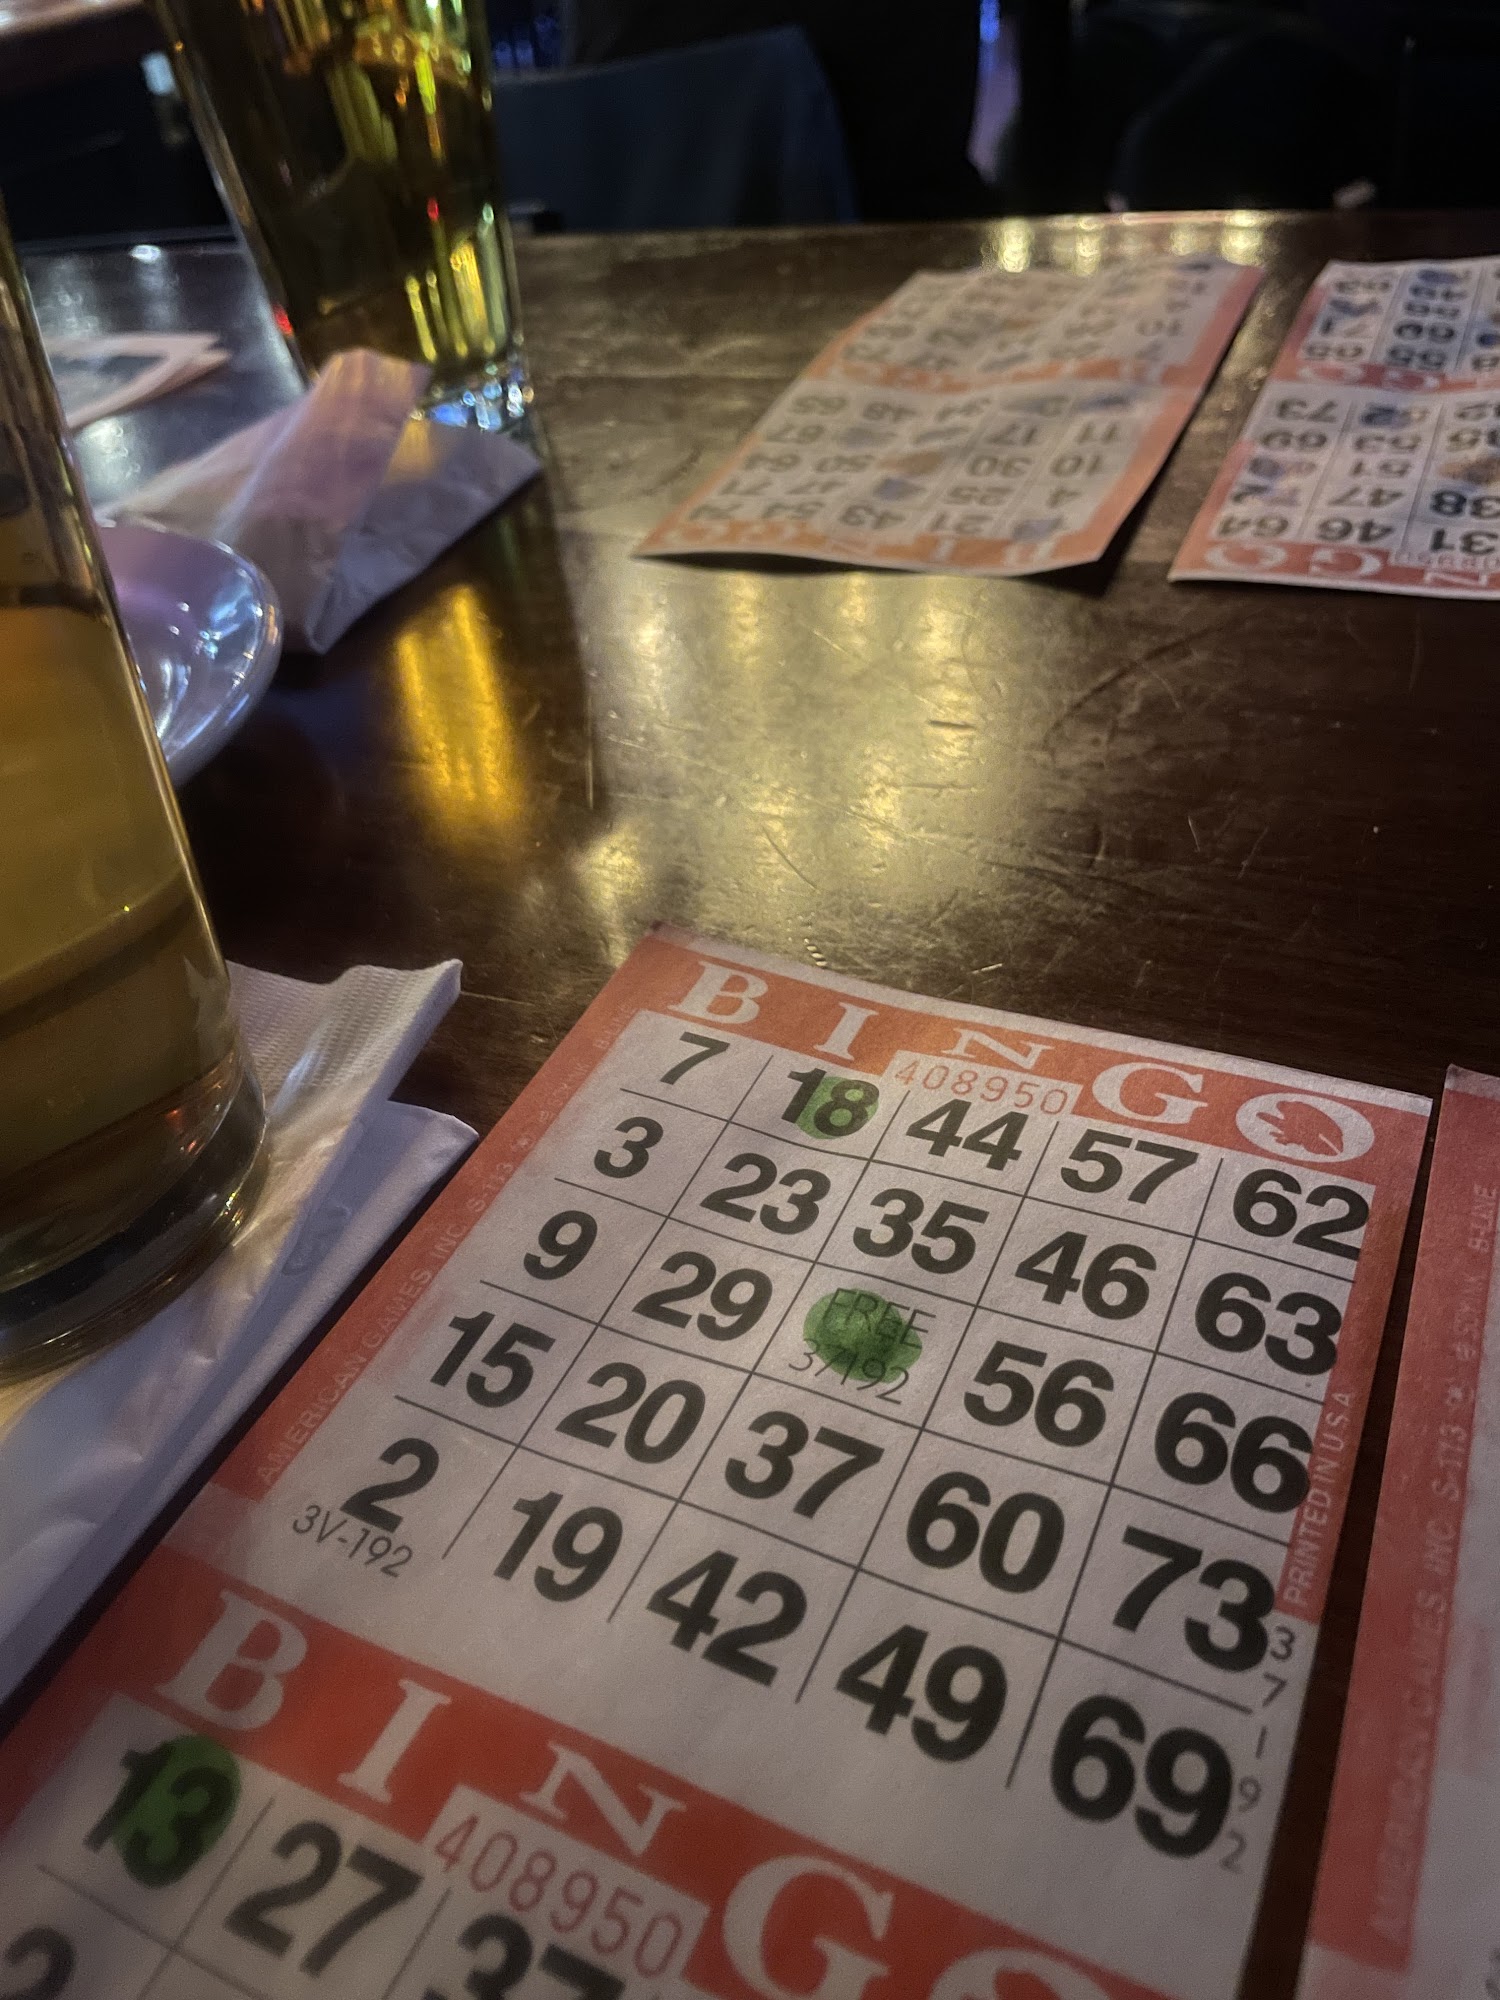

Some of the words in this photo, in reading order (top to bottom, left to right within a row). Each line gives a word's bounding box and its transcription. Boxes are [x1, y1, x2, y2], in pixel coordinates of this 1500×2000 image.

[1315, 515, 1396, 544] 46
[1428, 526, 1499, 556] 31
[659, 1031, 731, 1086] 7
[780, 1067, 880, 1137] 18
[906, 1098, 1030, 1172] 44
[1060, 1128, 1200, 1205] 57
[1232, 1168, 1370, 1262] 62
[895, 1059, 1071, 1116] 408950
[593, 1115, 665, 1179] 3
[700, 1152, 832, 1236] 23
[852, 1187, 991, 1275] 35
[1014, 1230, 1158, 1321] 46
[1194, 1272, 1343, 1376] 63
[821, 1287, 937, 1350] FREE
[522, 1209, 599, 1281] 9
[631, 1250, 774, 1342] 29
[962, 1340, 1115, 1448] 56
[1154, 1392, 1314, 1514] 66
[292, 1504, 414, 1579] 3V-192
[429, 1310, 557, 1408] 15
[555, 1361, 706, 1464] 20
[724, 1410, 885, 1519] 37
[905, 1471, 1066, 1594] 60
[1111, 1525, 1277, 1672] 73
[1282, 1490, 1333, 1606] PRINTED
[1311, 1456, 1338, 1485] IN
[339, 1436, 440, 1534] 2
[492, 1490, 624, 1603] 19
[645, 1550, 808, 1688] 42
[835, 1624, 1009, 1763] 49
[1049, 1694, 1234, 1858] 69
[82, 1748, 234, 1887] 13
[222, 1819, 426, 1979] 27
[433, 1814, 685, 1979] 408950
